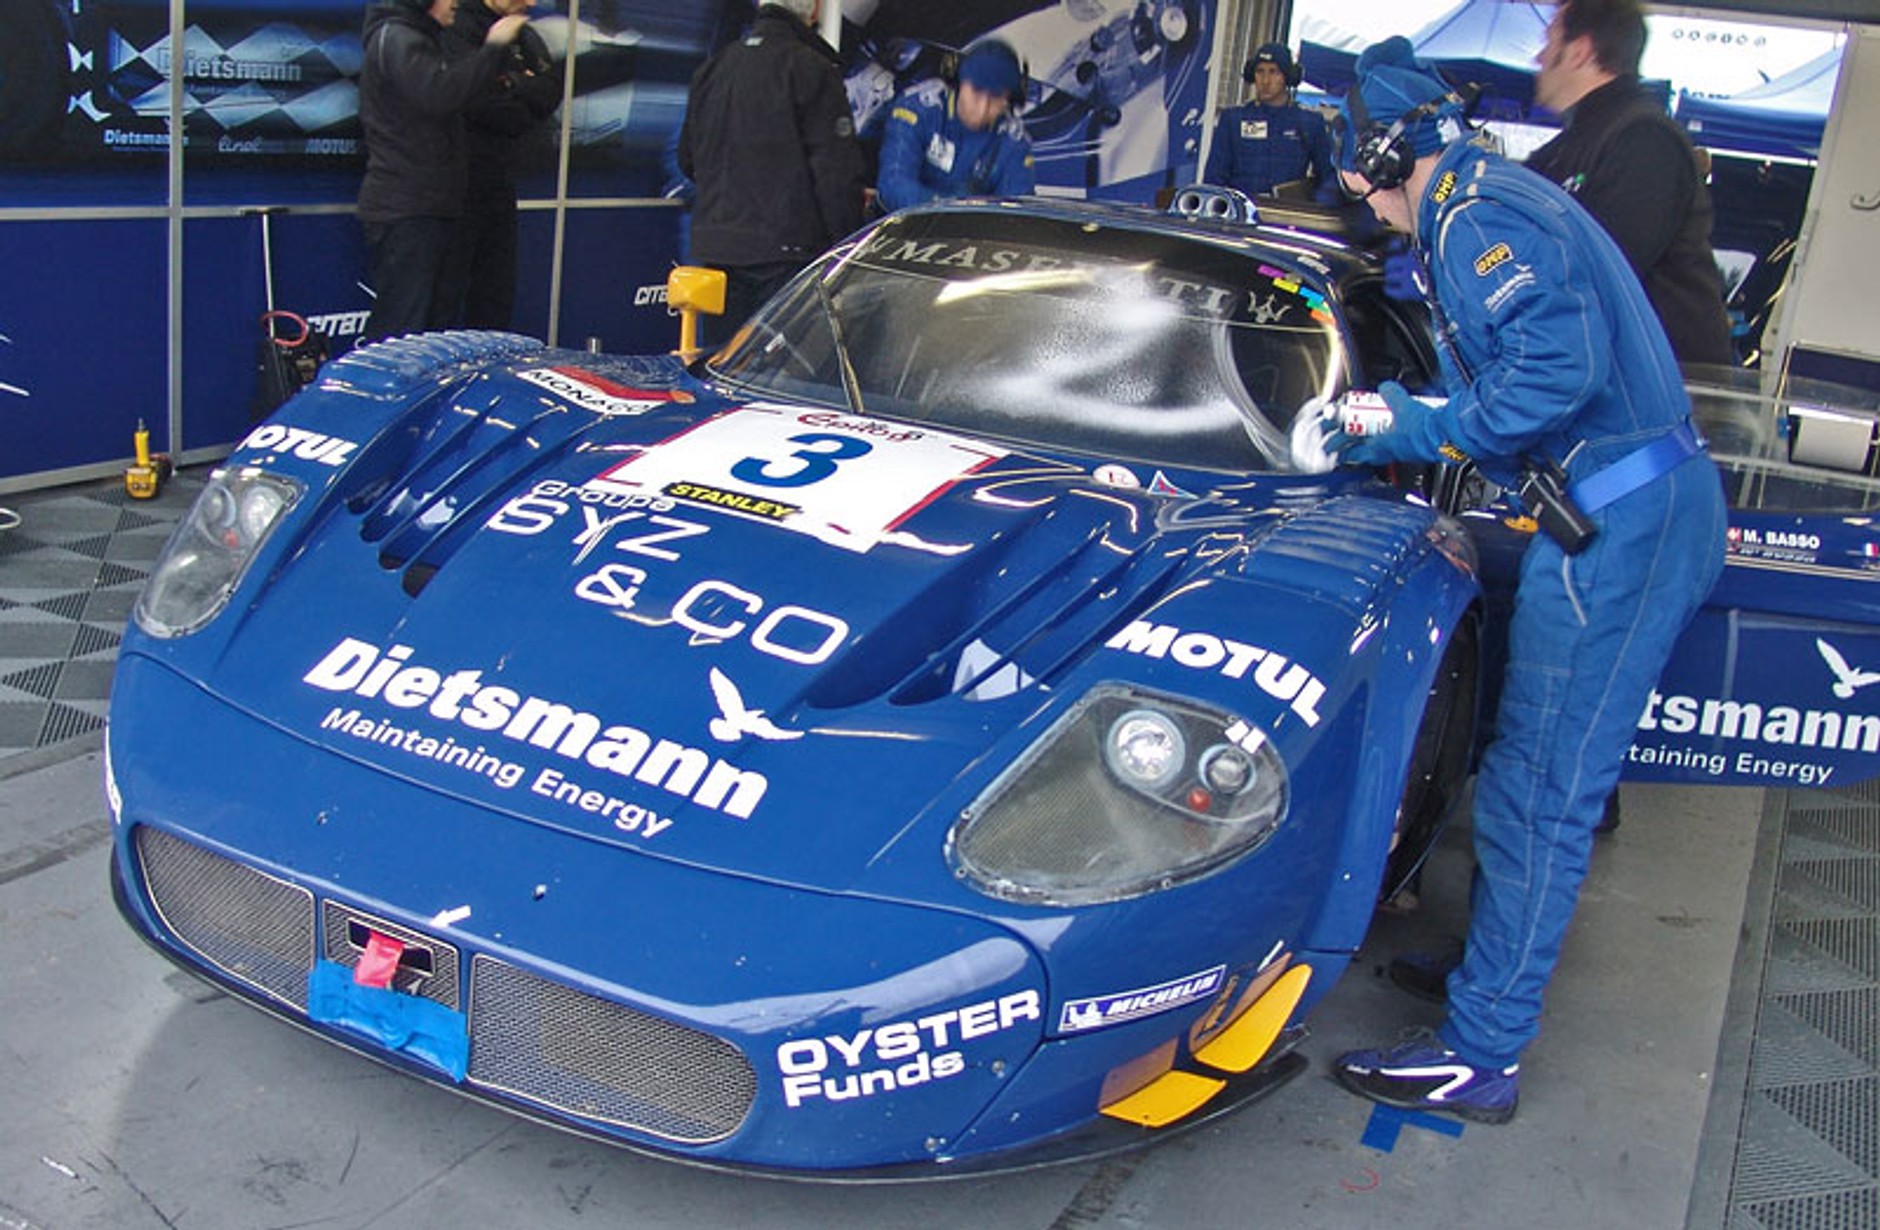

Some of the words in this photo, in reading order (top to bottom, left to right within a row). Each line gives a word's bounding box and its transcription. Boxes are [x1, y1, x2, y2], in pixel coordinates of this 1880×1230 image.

[730, 433, 873, 489] 3
[487, 496, 711, 563] SYZ
[671, 483, 797, 520] STANLEY
[575, 563, 647, 609] &
[672, 581, 850, 665] CO
[1104, 620, 1327, 728] MOTUL
[302, 637, 769, 820] Dietsmann
[320, 707, 526, 789] Maintaining
[531, 768, 674, 839] Energy
[1736, 752, 1834, 786] Energy
[1107, 973, 1218, 1016] MICHELIN
[776, 990, 1040, 1076] OYSTER
[781, 1051, 965, 1107] Funds
